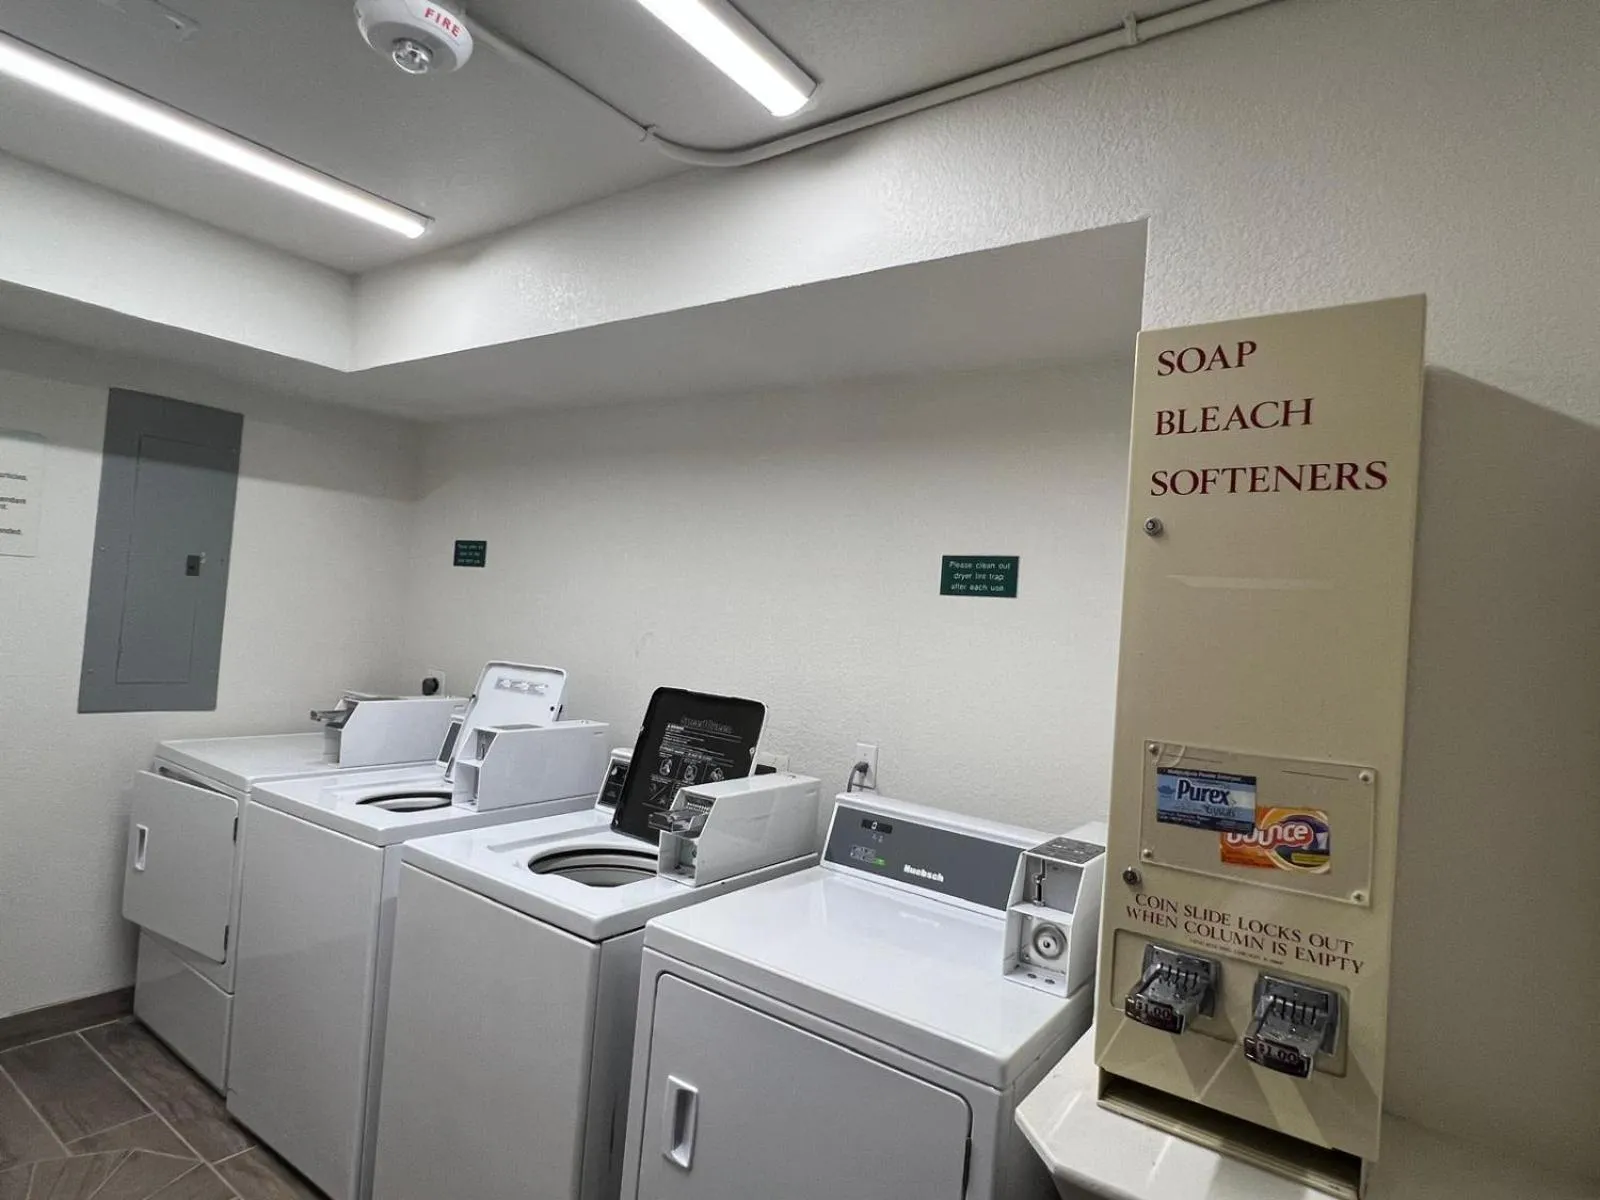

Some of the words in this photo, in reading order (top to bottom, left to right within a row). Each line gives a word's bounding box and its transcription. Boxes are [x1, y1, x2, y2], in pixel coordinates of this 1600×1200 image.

[424, 7, 461, 37] FIRE
[1157, 340, 1257, 377] SOAP
[1155, 398, 1315, 436] BLEACH
[1150, 460, 1388, 497] SOFTENERS
[949, 561, 972, 569] Please
[953, 572, 972, 580] dryer
[975, 572, 987, 580] lint
[989, 573, 1004, 581] trap
[1177, 779, 1230, 806] Purex
[903, 864, 944, 883] Huebsch
[1126, 906, 1178, 928] WHEN
[1184, 920, 1265, 950] COLUMN
[1272, 941, 1287, 956] IS
[1295, 946, 1364, 974] EMPTY
[1135, 893, 1178, 914] COIN
[1183, 904, 1231, 926] SLIDE
[1238, 916, 1301, 943] LOCKS
[1309, 933, 1355, 954] OUT
